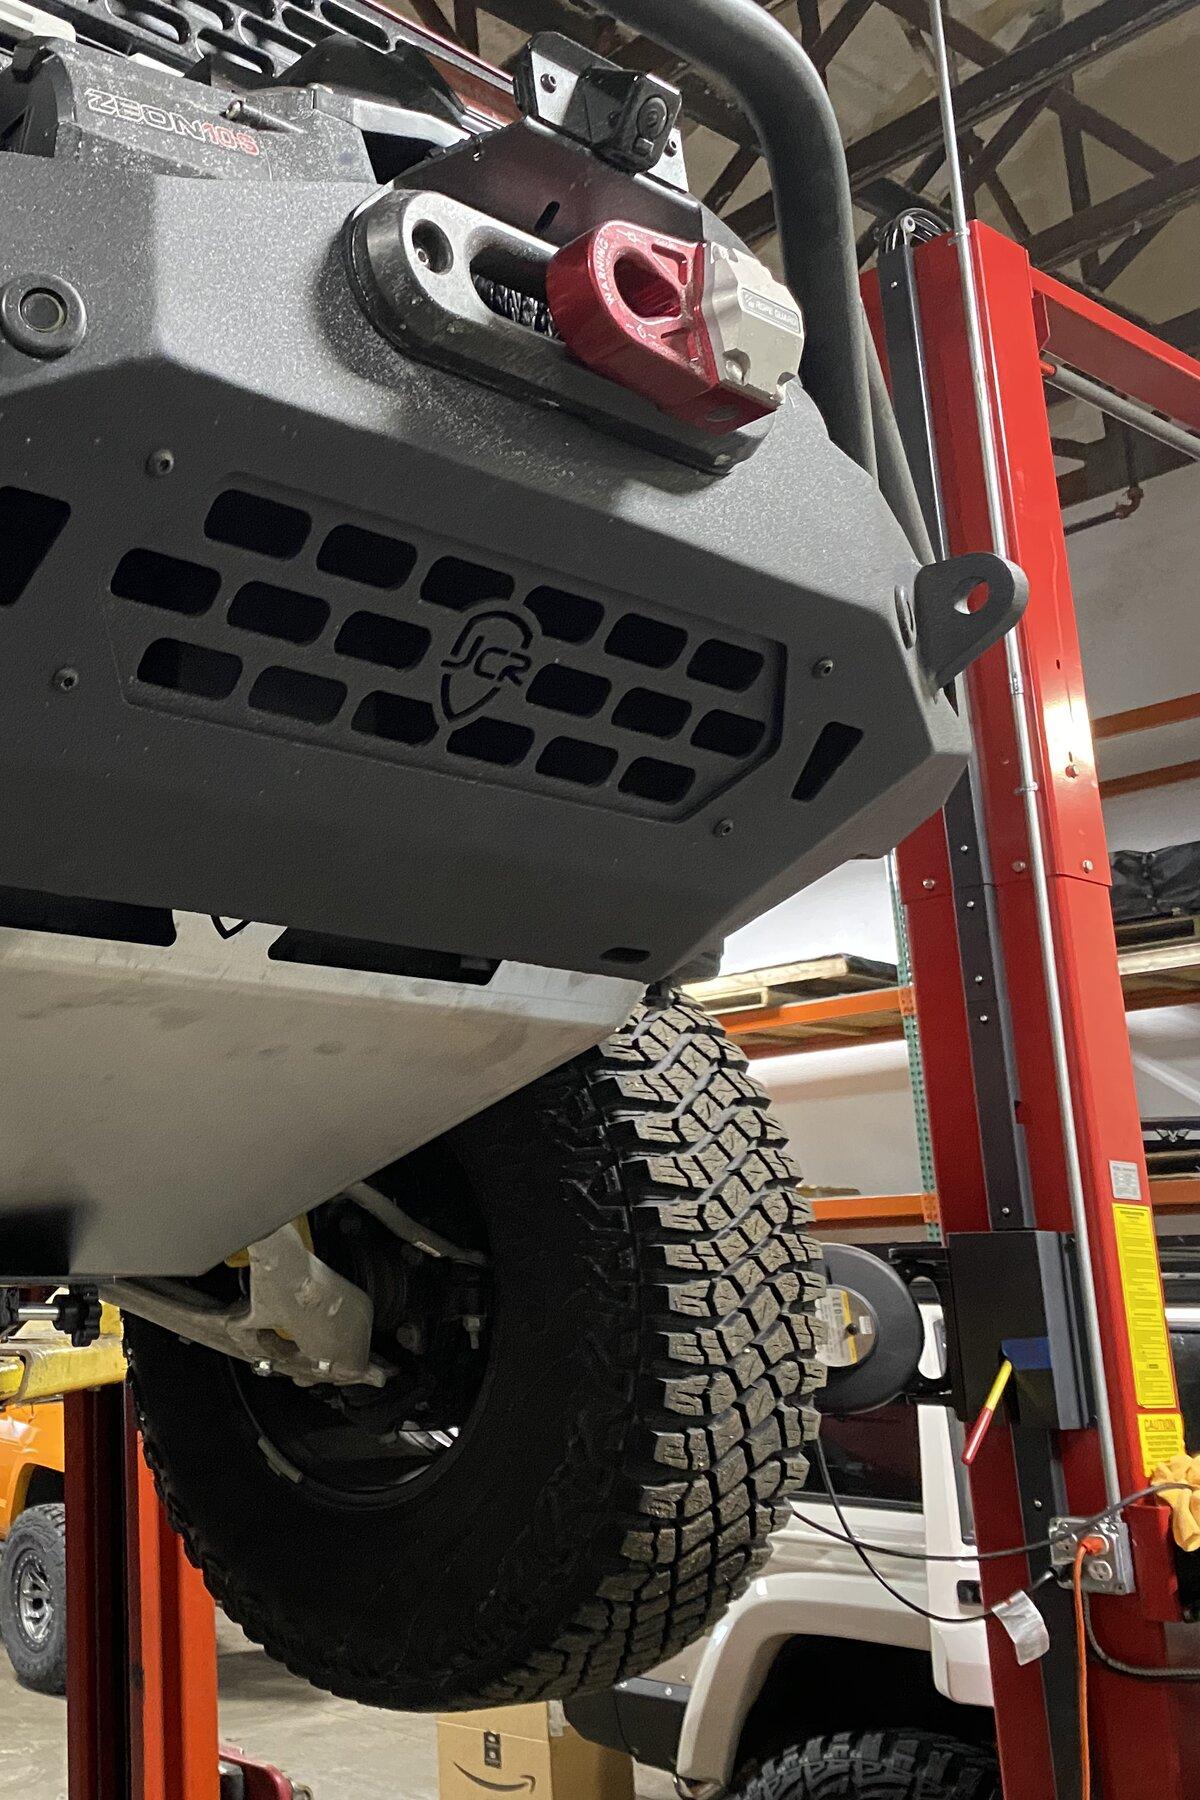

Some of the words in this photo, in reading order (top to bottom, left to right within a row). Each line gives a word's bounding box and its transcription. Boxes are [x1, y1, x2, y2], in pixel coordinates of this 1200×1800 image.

[84, 88, 206, 142] ZEON
[596, 237, 614, 305] WARNING
[441, 635, 532, 687] JCR
[1143, 1418, 1177, 1431] CAUTION
